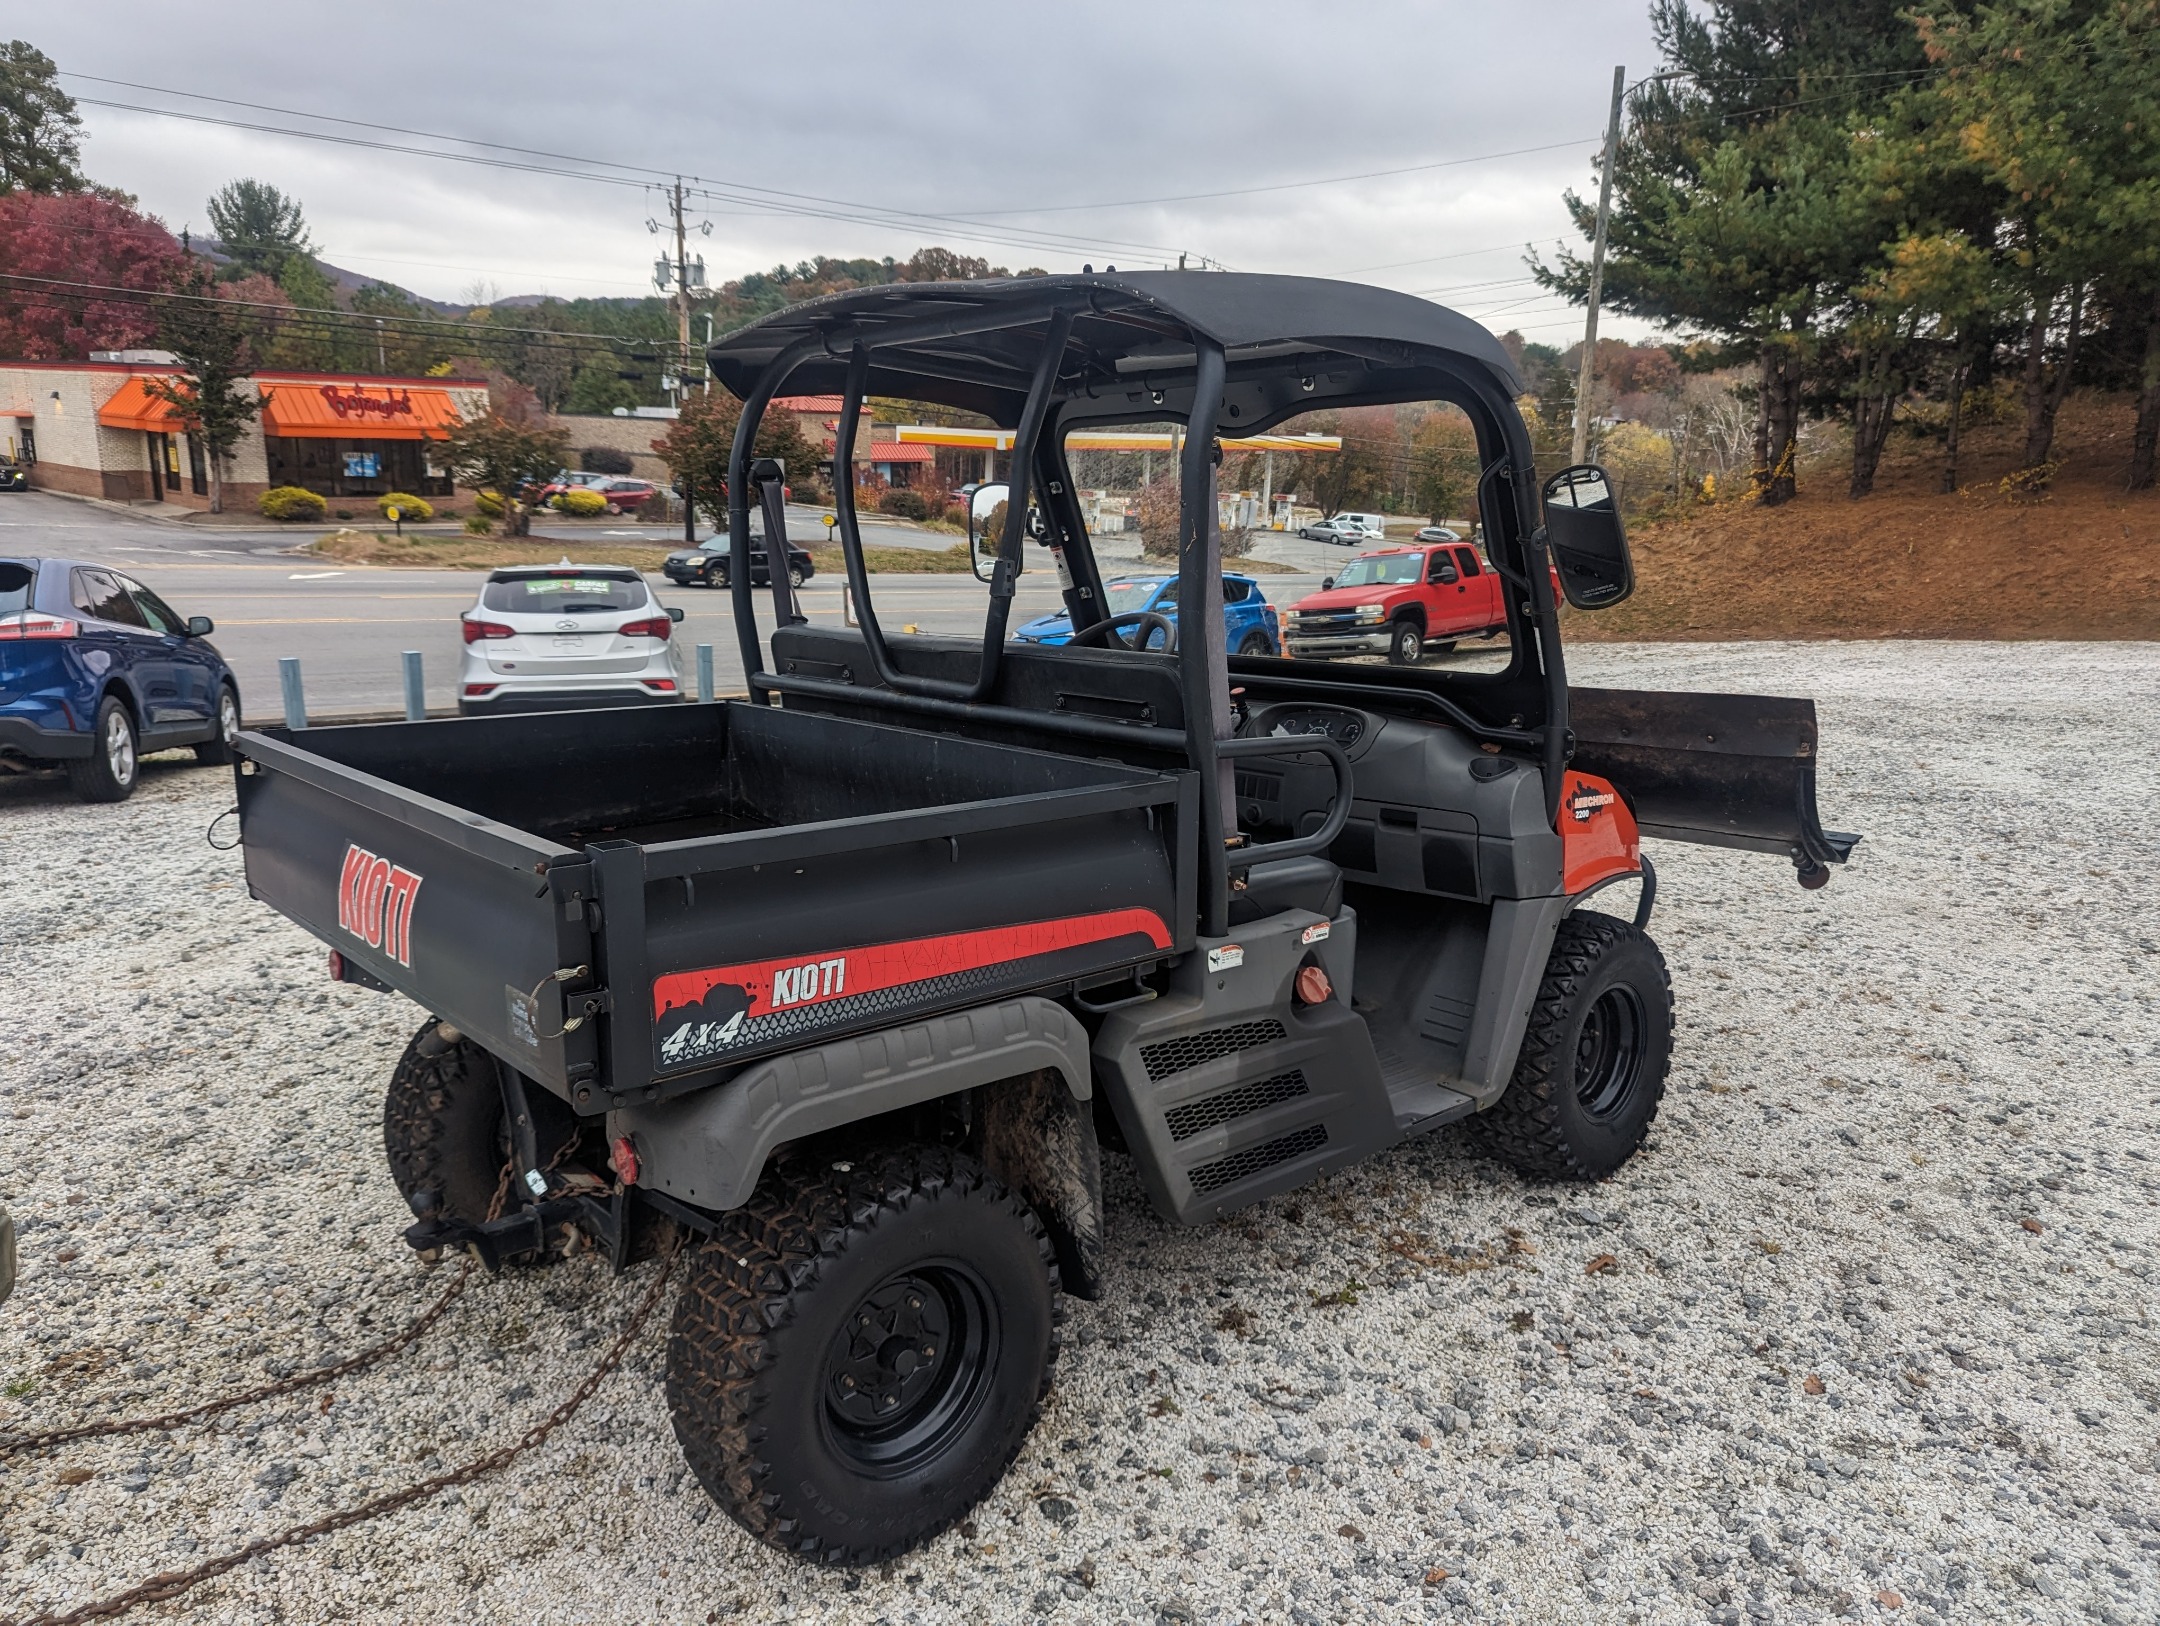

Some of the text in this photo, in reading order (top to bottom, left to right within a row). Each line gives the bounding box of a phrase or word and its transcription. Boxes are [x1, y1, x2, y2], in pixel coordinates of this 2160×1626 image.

[1574, 794, 1614, 808] MECHRON
[1575, 810, 1590, 818] 2200
[339, 843, 423, 968] KIOTI
[771, 957, 846, 1008] KIOTI
